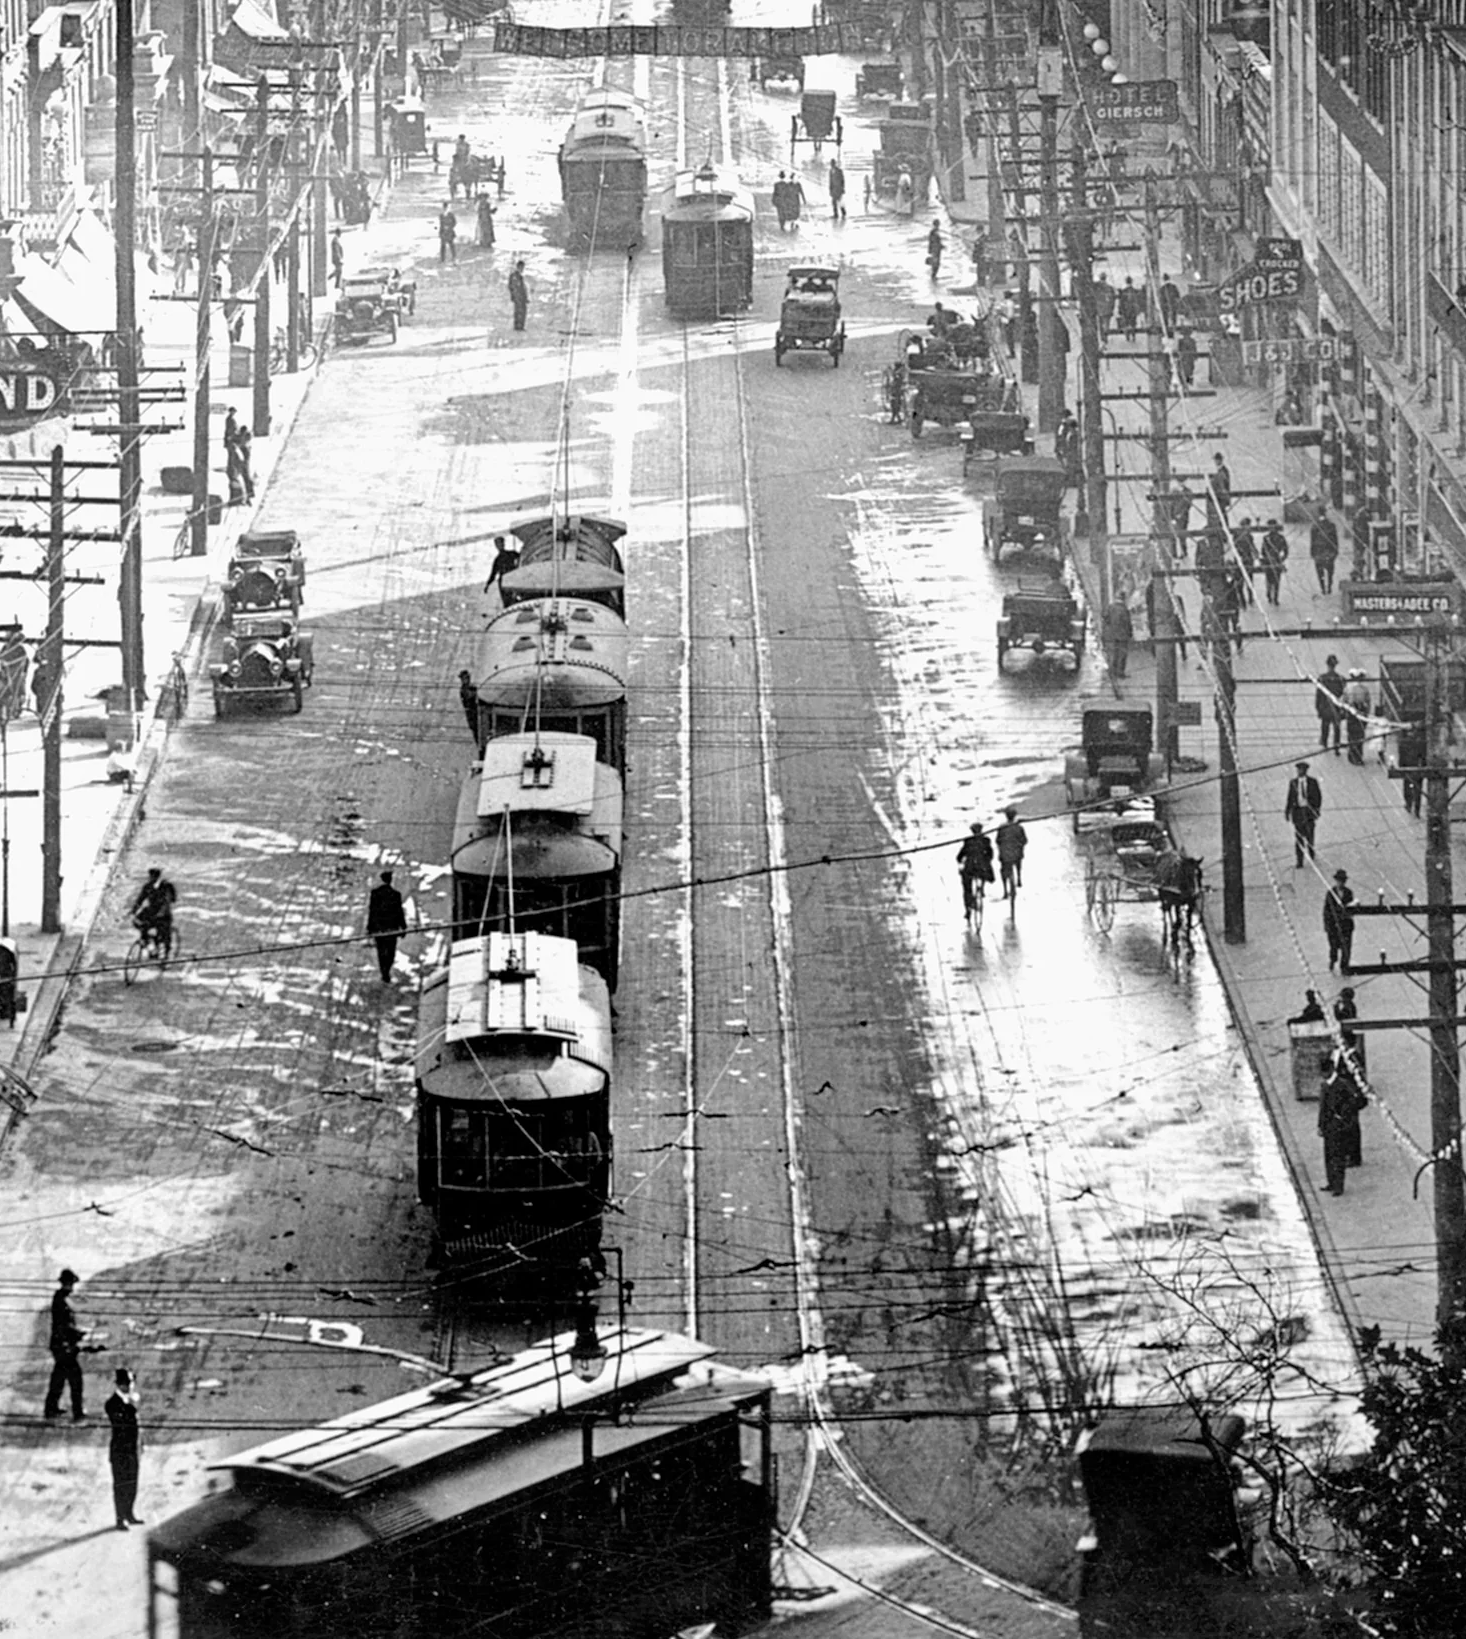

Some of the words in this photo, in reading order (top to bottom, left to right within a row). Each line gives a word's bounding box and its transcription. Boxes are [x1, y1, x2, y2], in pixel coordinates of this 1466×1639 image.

[1093, 86, 1167, 104] HOTEL
[1096, 106, 1163, 118] GIERSCH
[1219, 270, 1298, 310] SHOES
